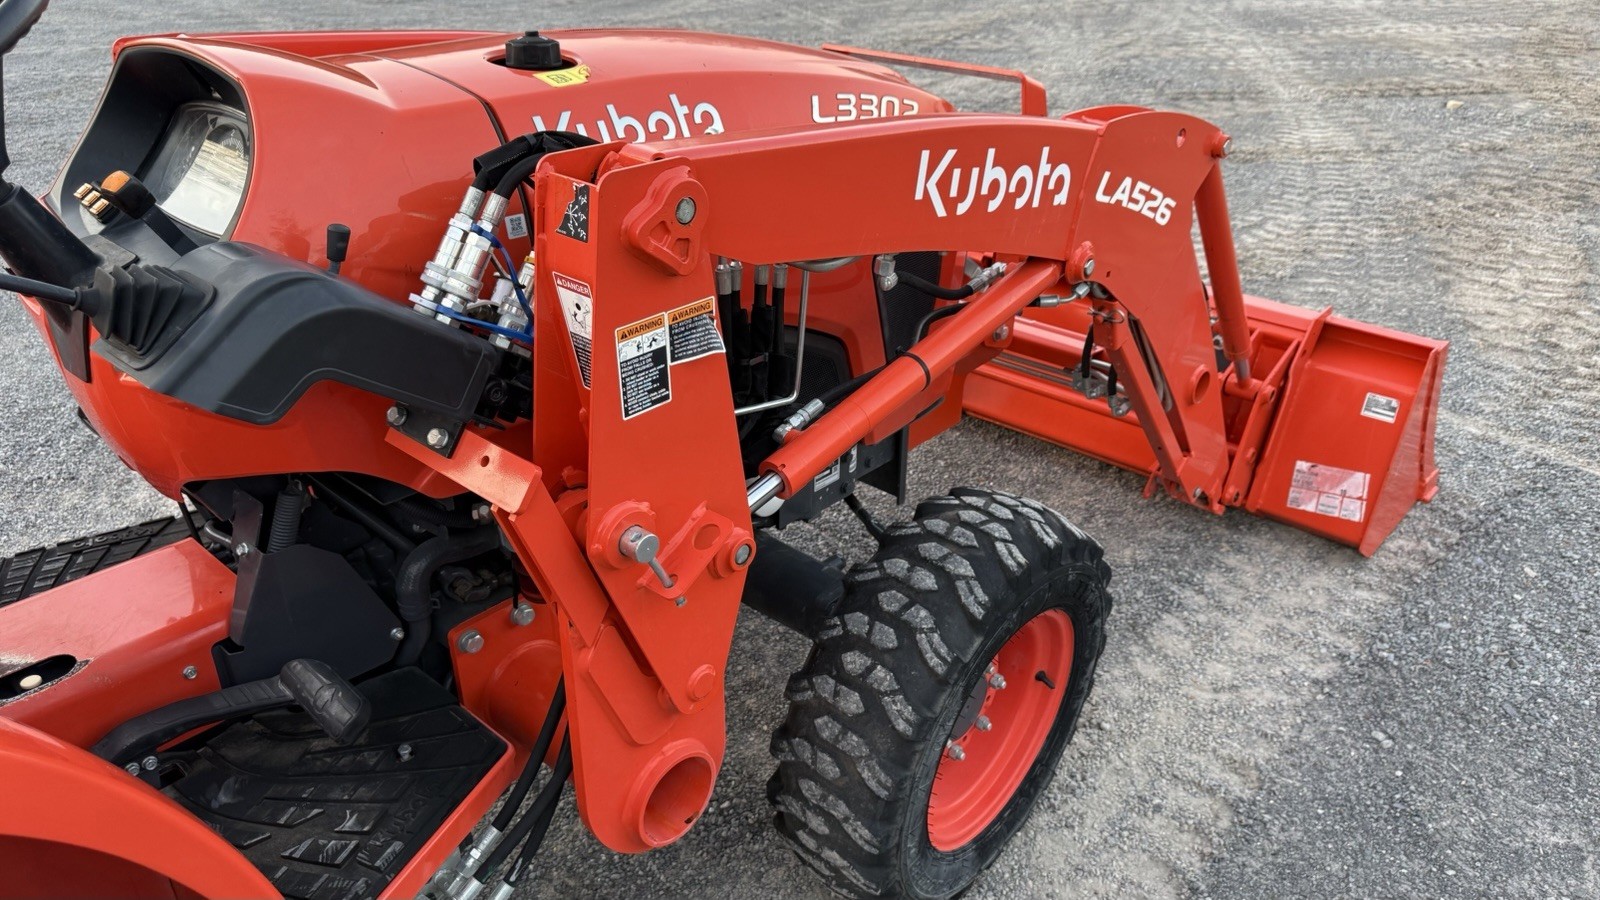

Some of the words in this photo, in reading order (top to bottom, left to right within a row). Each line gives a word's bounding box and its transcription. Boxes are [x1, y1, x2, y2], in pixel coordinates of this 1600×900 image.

[914, 146, 1072, 218] Kubota
[1095, 171, 1177, 226] LA526
[561, 279, 590, 295] DANGER
[677, 302, 711, 320] WARNING
[627, 318, 663, 337] WARNING
